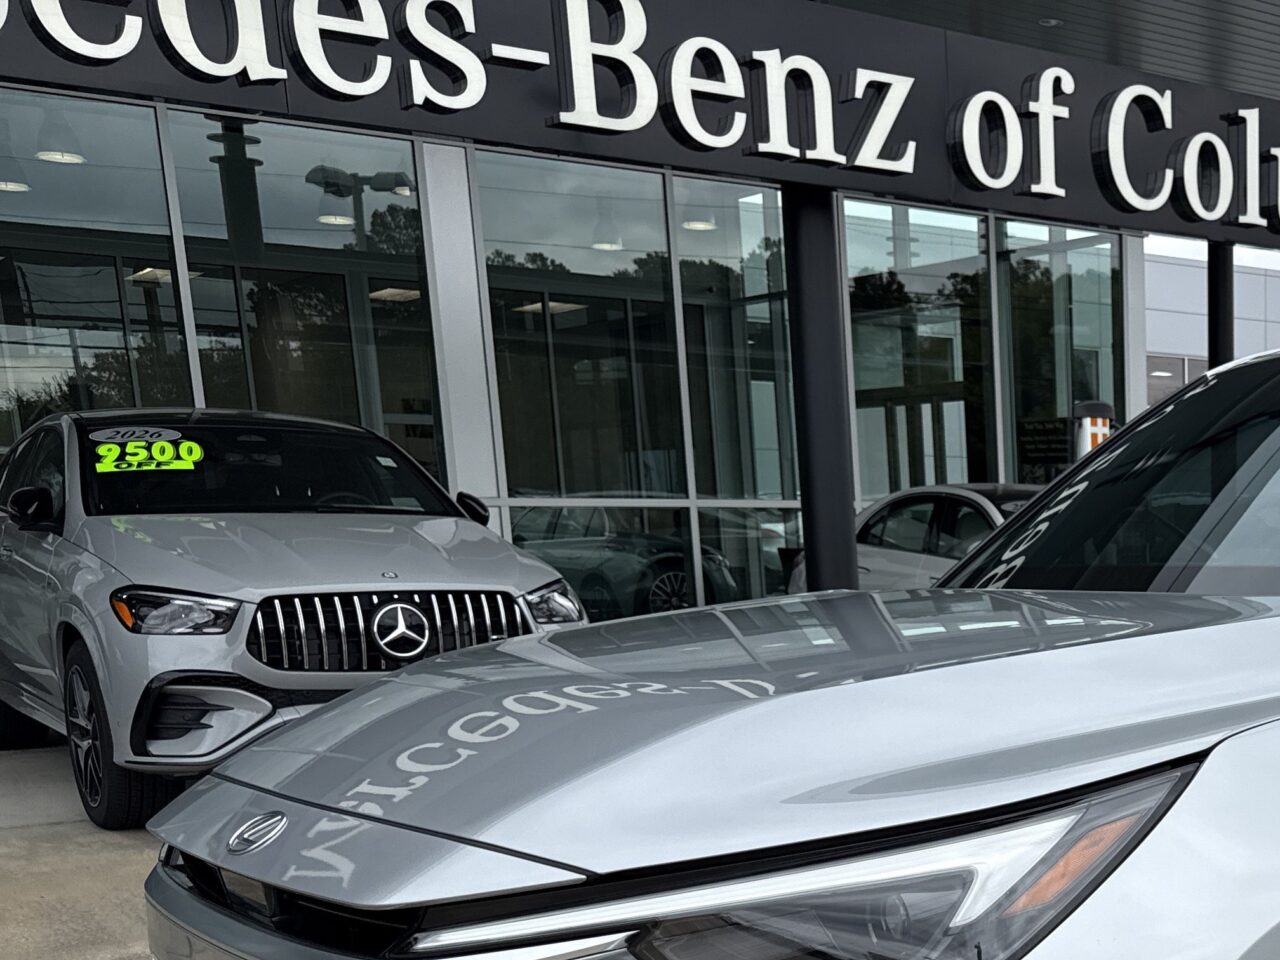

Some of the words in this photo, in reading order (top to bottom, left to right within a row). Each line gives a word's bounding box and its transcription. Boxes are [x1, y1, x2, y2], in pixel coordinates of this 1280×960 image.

[0, 0, 916, 173] es-Benz
[962, 67, 1075, 197] of
[105, 430, 163, 439] 2026
[114, 461, 174, 470] OFF
